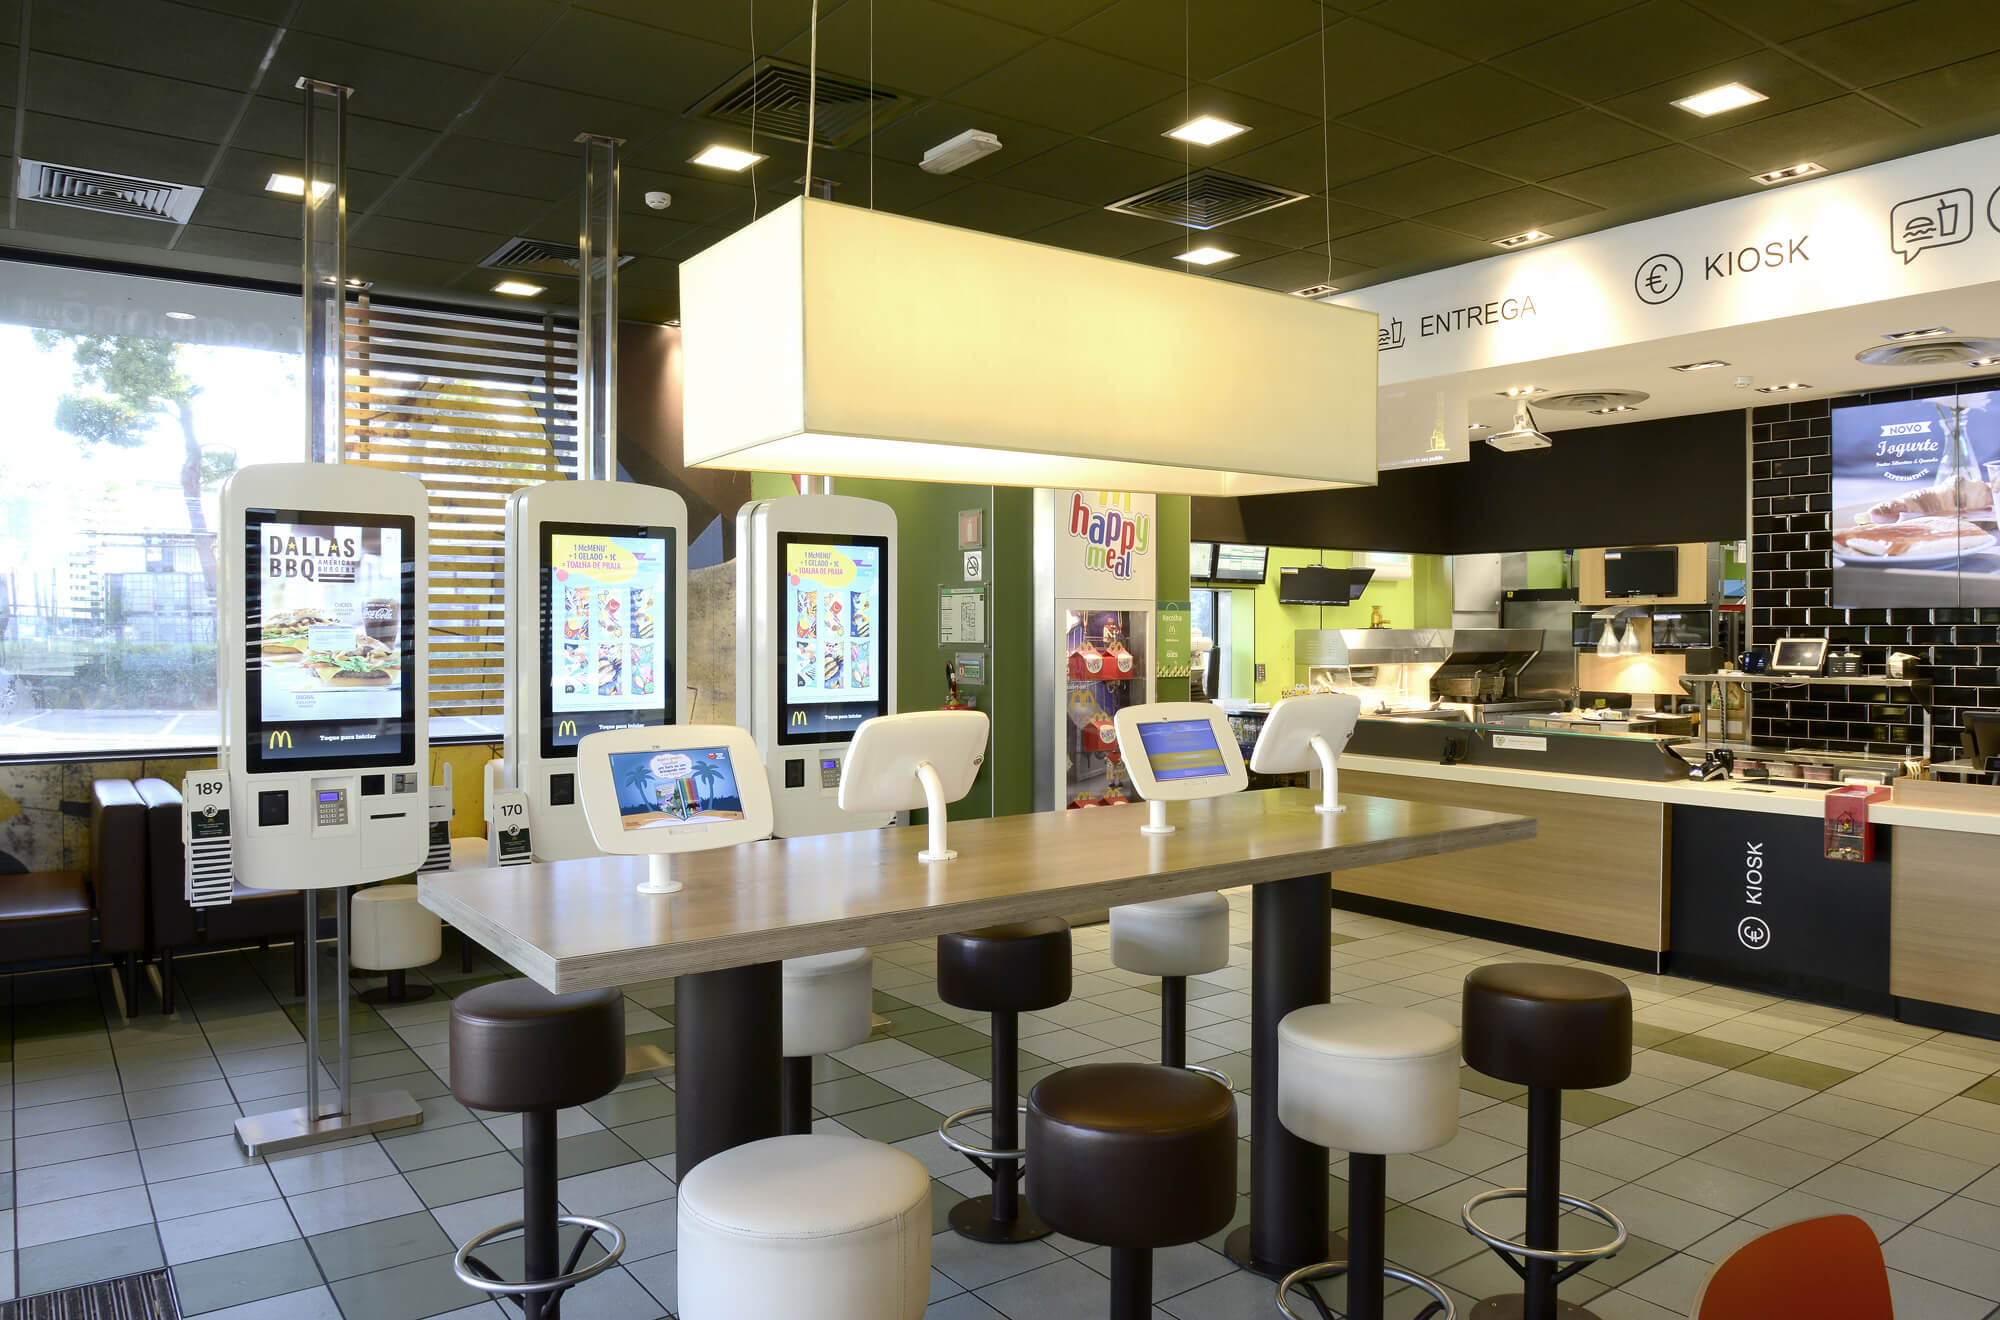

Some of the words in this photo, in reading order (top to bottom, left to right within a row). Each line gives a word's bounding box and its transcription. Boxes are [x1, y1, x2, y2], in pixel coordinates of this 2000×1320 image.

[1704, 235, 1811, 281] KIOSK
[1420, 294, 1537, 338] ENTREGA
[1890, 424, 1922, 435] NOVO
[1884, 468, 1930, 481] EXPERIMENTE
[1071, 492, 1149, 556] happy
[270, 535, 355, 557] DALLAS
[270, 558, 314, 582] BBQ
[1087, 544, 1131, 578] meal
[195, 781, 223, 796] 189
[501, 803, 523, 817] 170
[1745, 840, 1763, 905] KIOSK
